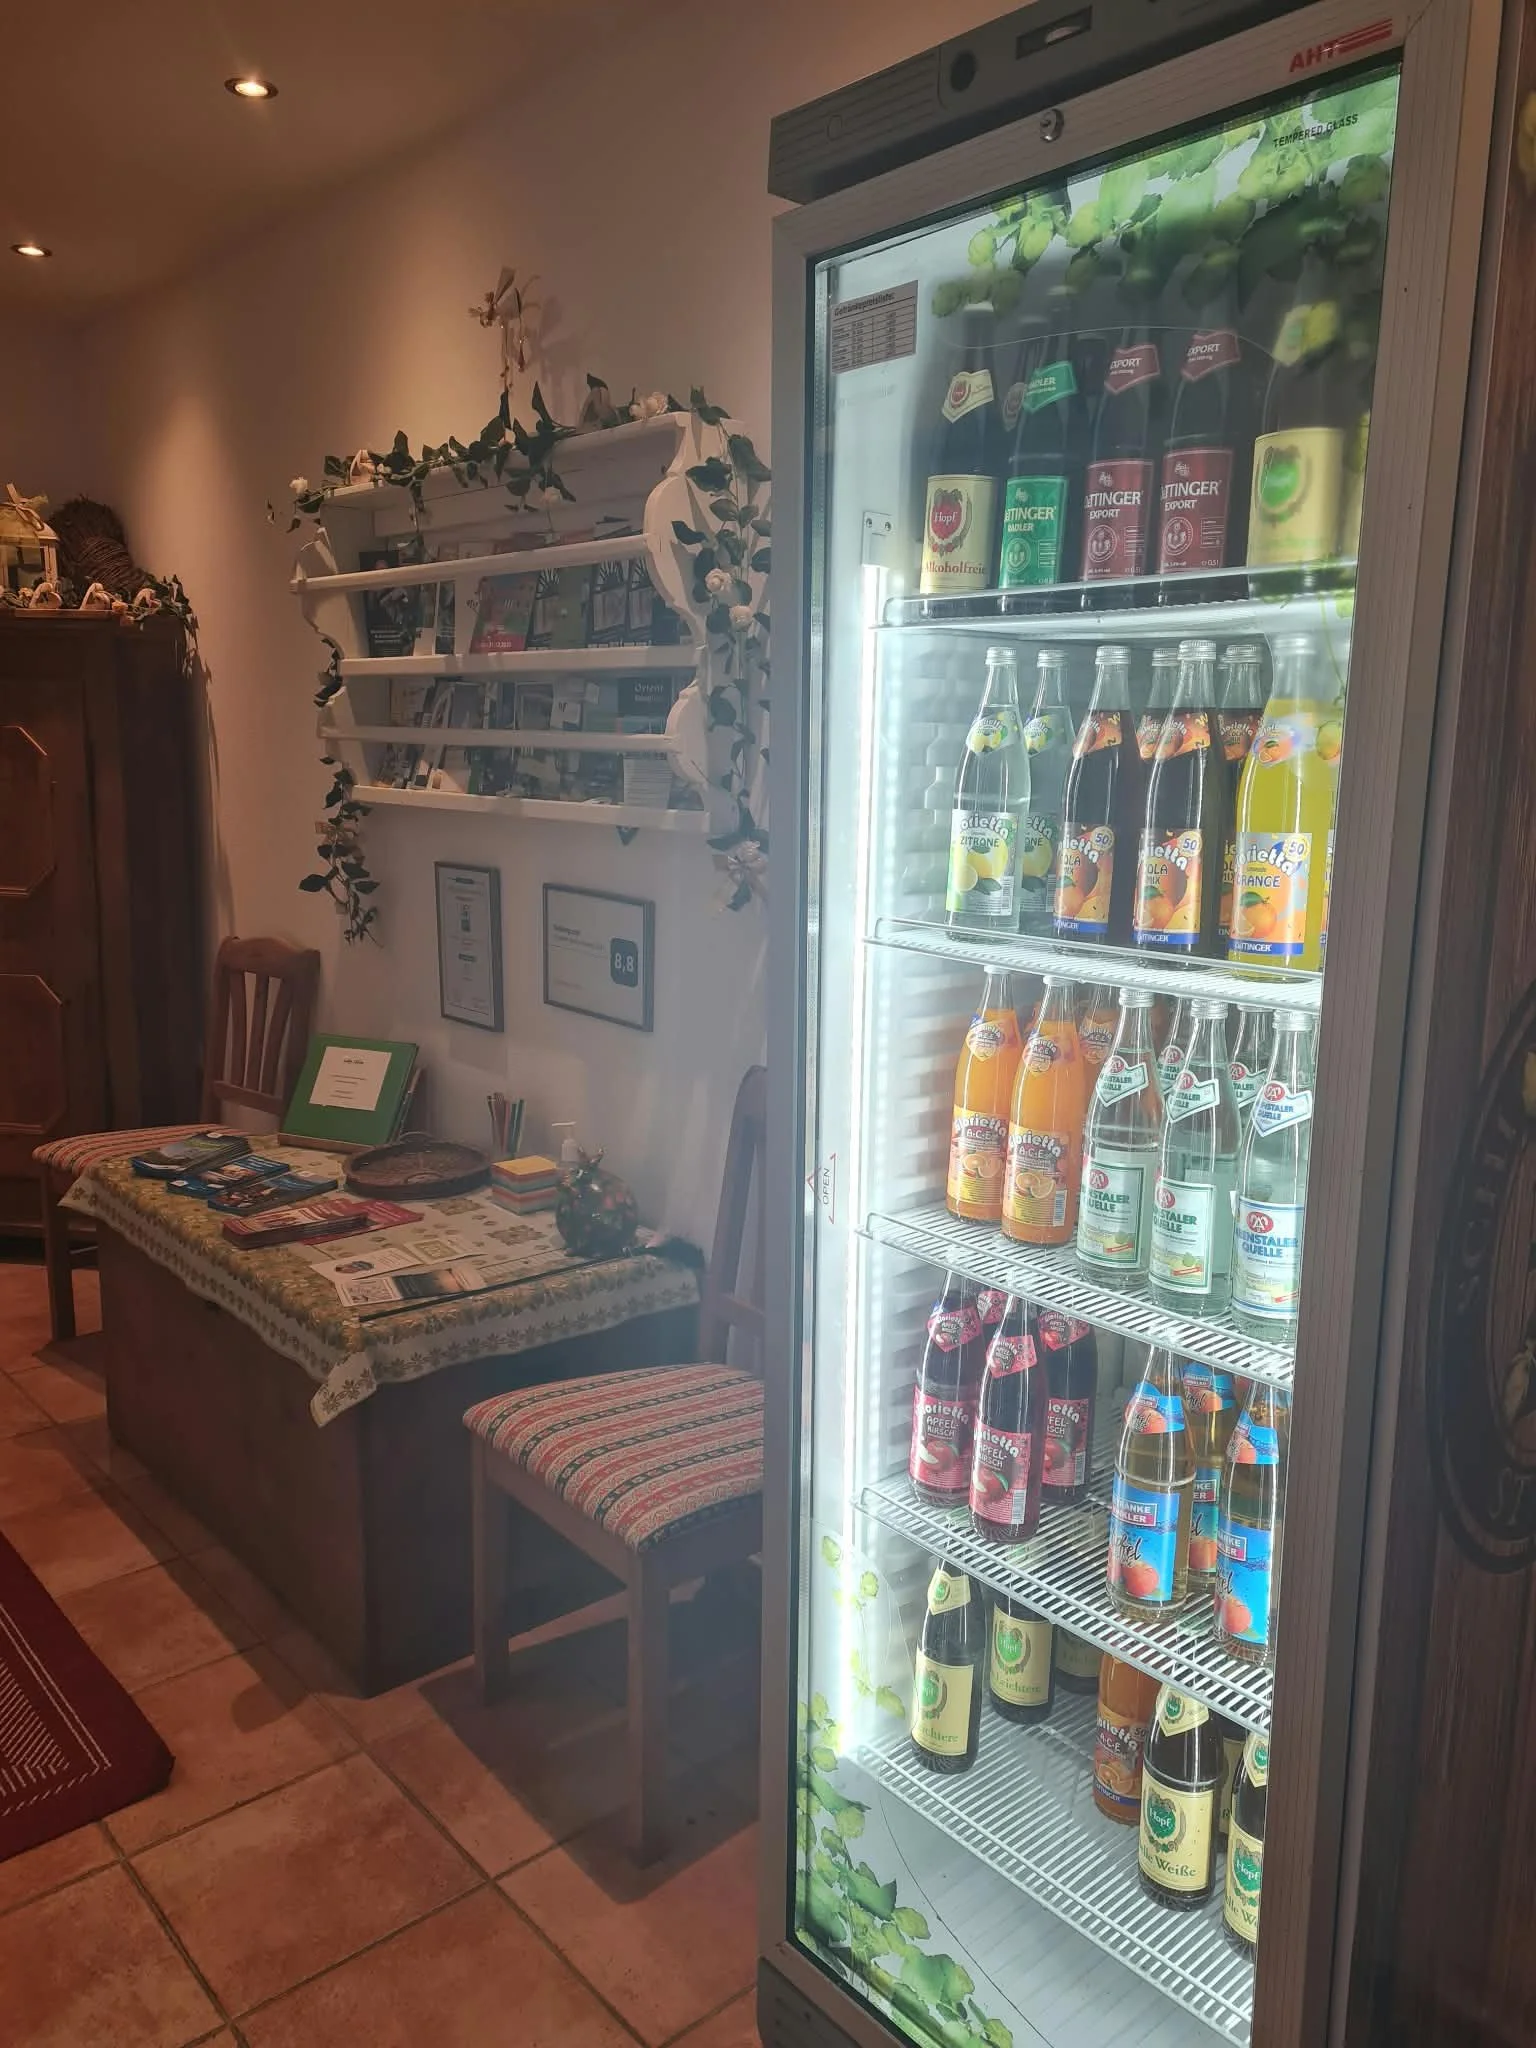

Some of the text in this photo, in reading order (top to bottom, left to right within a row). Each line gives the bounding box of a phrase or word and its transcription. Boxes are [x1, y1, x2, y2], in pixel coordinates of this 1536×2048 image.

[1289, 38, 1340, 73] AHT
[1273, 114, 1358, 148] TEMPERED GLASS
[934, 510, 958, 526] Hopf
[960, 836, 1000, 848] ZITRONE
[1095, 833, 1109, 845] 50
[1183, 838, 1197, 851] 50
[1288, 843, 1305, 856] 50
[614, 952, 635, 973] 8,8
[822, 1167, 831, 1205] OPEN
[1242, 1241, 1284, 1258] QUELLE
[926, 1414, 960, 1428] APFEL-
[926, 1426, 956, 1437] KIRSCH
[1149, 1807, 1172, 1828] Hopf
[1154, 1855, 1197, 1877] Weiße
